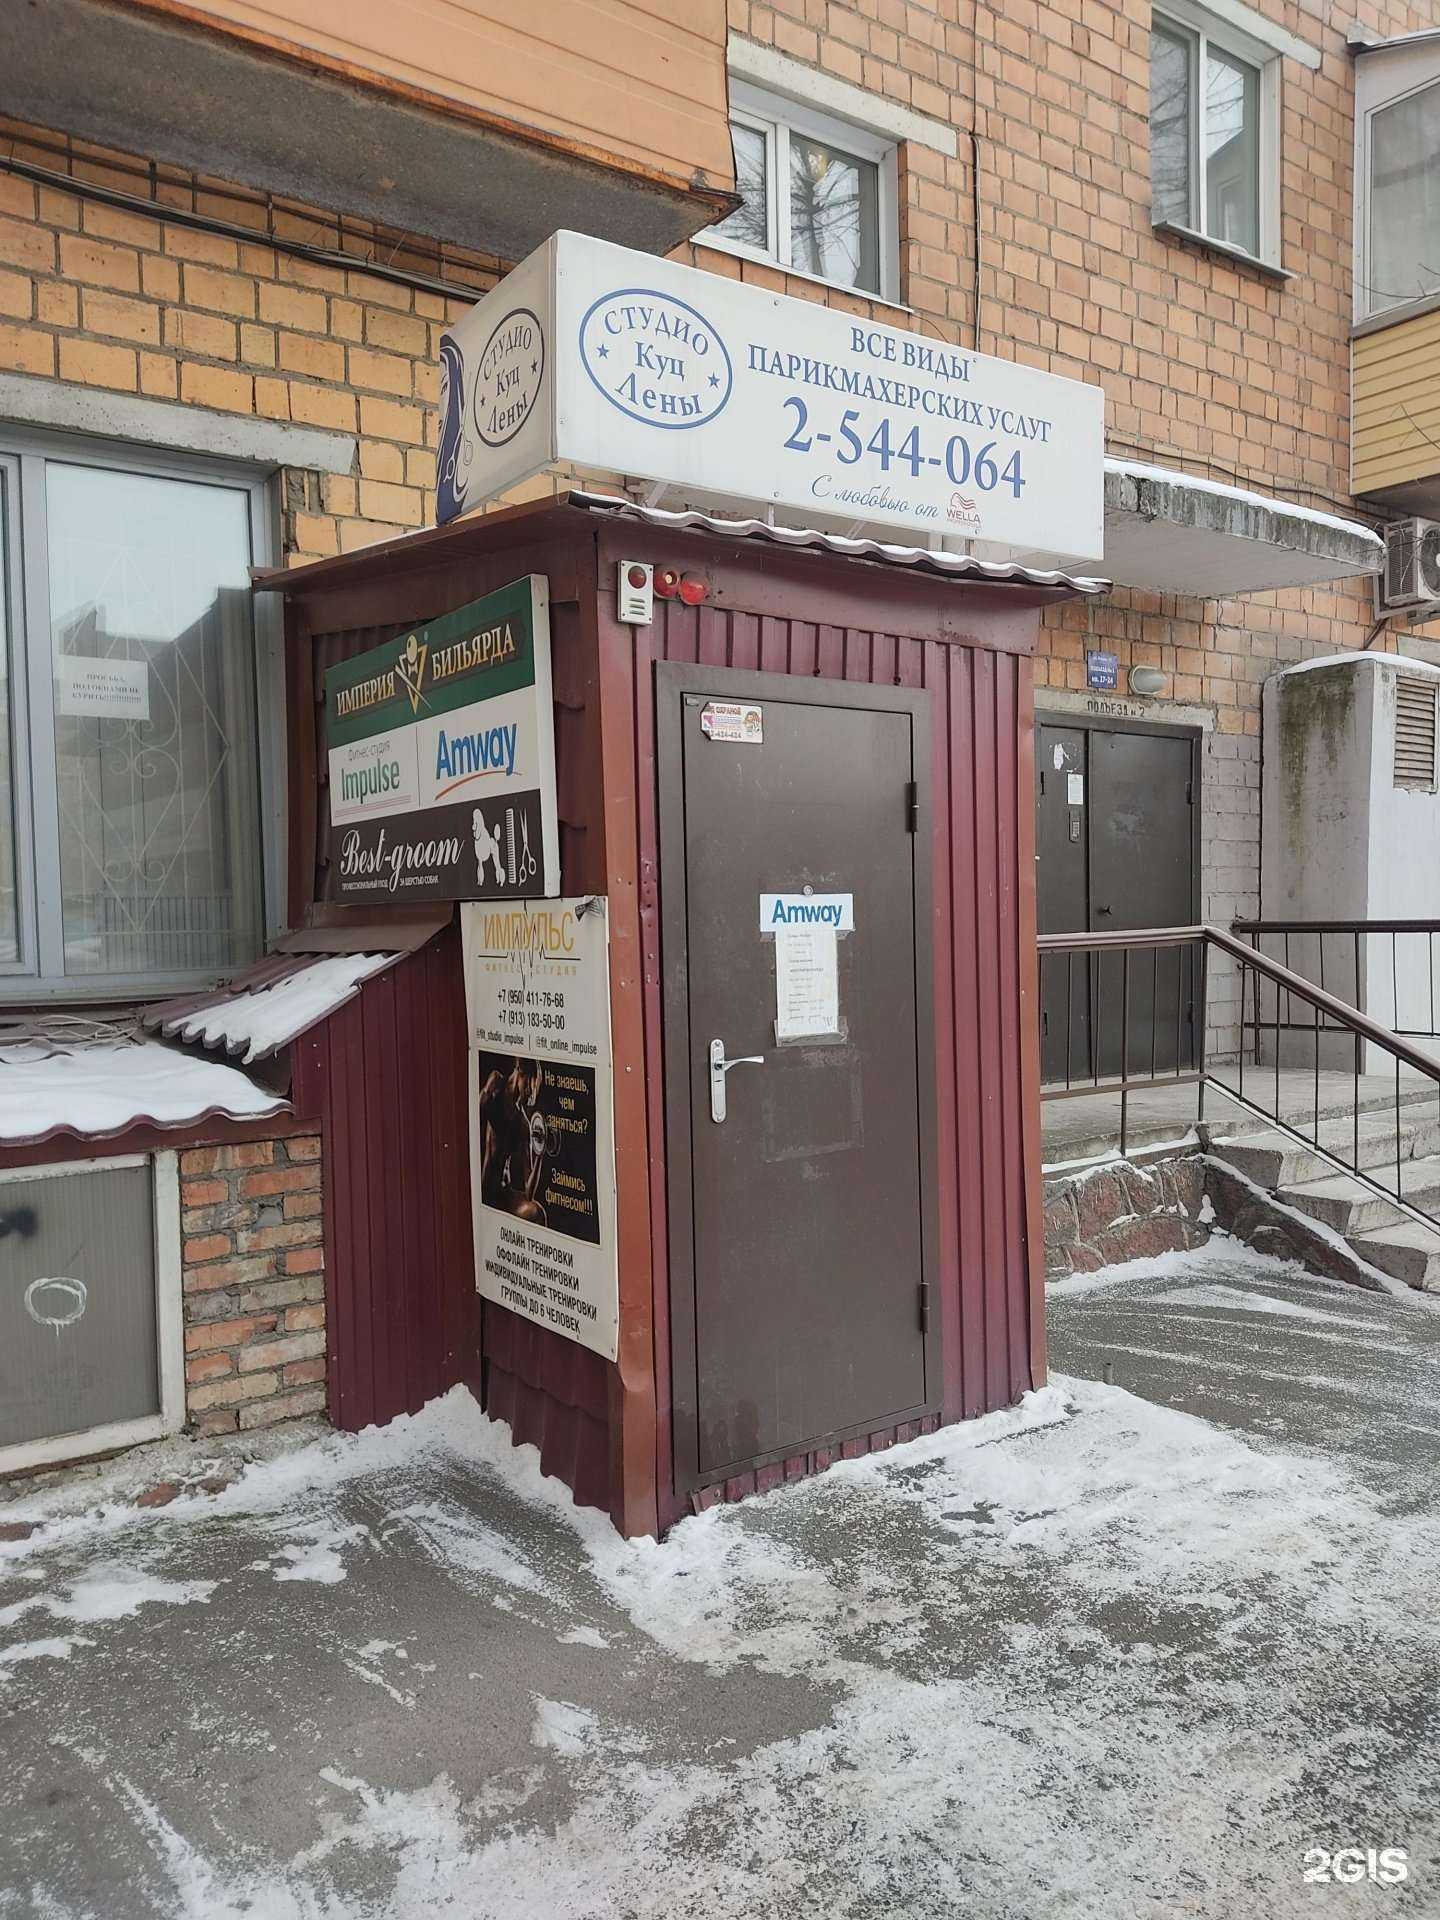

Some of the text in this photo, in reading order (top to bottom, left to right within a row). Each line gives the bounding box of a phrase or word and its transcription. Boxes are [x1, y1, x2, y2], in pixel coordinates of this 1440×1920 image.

[604, 306, 709, 356] СТУДИО
[483, 325, 532, 381] СТУДИО
[634, 341, 686, 382] Куц
[850, 327, 970, 382] ВСЕ ВИДЫ
[495, 366, 521, 399] Куц
[614, 372, 703, 417] Лены
[748, 343, 1052, 443] ПАРИКМАХЕРСКИХ УСЛУГ
[486, 391, 529, 434] Лены
[783, 396, 1027, 499] 2-544-064
[834, 484, 910, 514] любовью
[915, 503, 939, 518] от
[946, 508, 982, 524] WELLA
[336, 623, 515, 716] ИМПЕРИЯ БИЛЬЯРДА
[1087, 700, 1129, 716] ПОДЪЕЗД
[436, 723, 518, 780] Amway
[341, 758, 400, 804] Impulse
[340, 828, 465, 893] Best-groom
[484, 911, 575, 952] ИМПУЛЬС
[772, 899, 843, 927] Amway
[498, 988, 565, 1009] +7 (950) 411-76-68
[498, 1009, 565, 1031] +7 (913) 183-50-00
[544, 1070, 555, 1087] Не
[558, 1095, 575, 1111] чем
[551, 1167, 586, 1192] Займись
[496, 1245, 580, 1292] ОФФЛАЙН ТРЕНИРОВКИ
[500, 1226, 574, 1269] ОНЛАЙН ТРЕНИРОВКИ
[485, 1259, 597, 1322] ИНДИВИДУАЛЬНЫЕ ТРЕНИРОВКИ
[501, 1284, 581, 1335] ГРУППЫ ДО 6 ЧЕЛОВЕК
